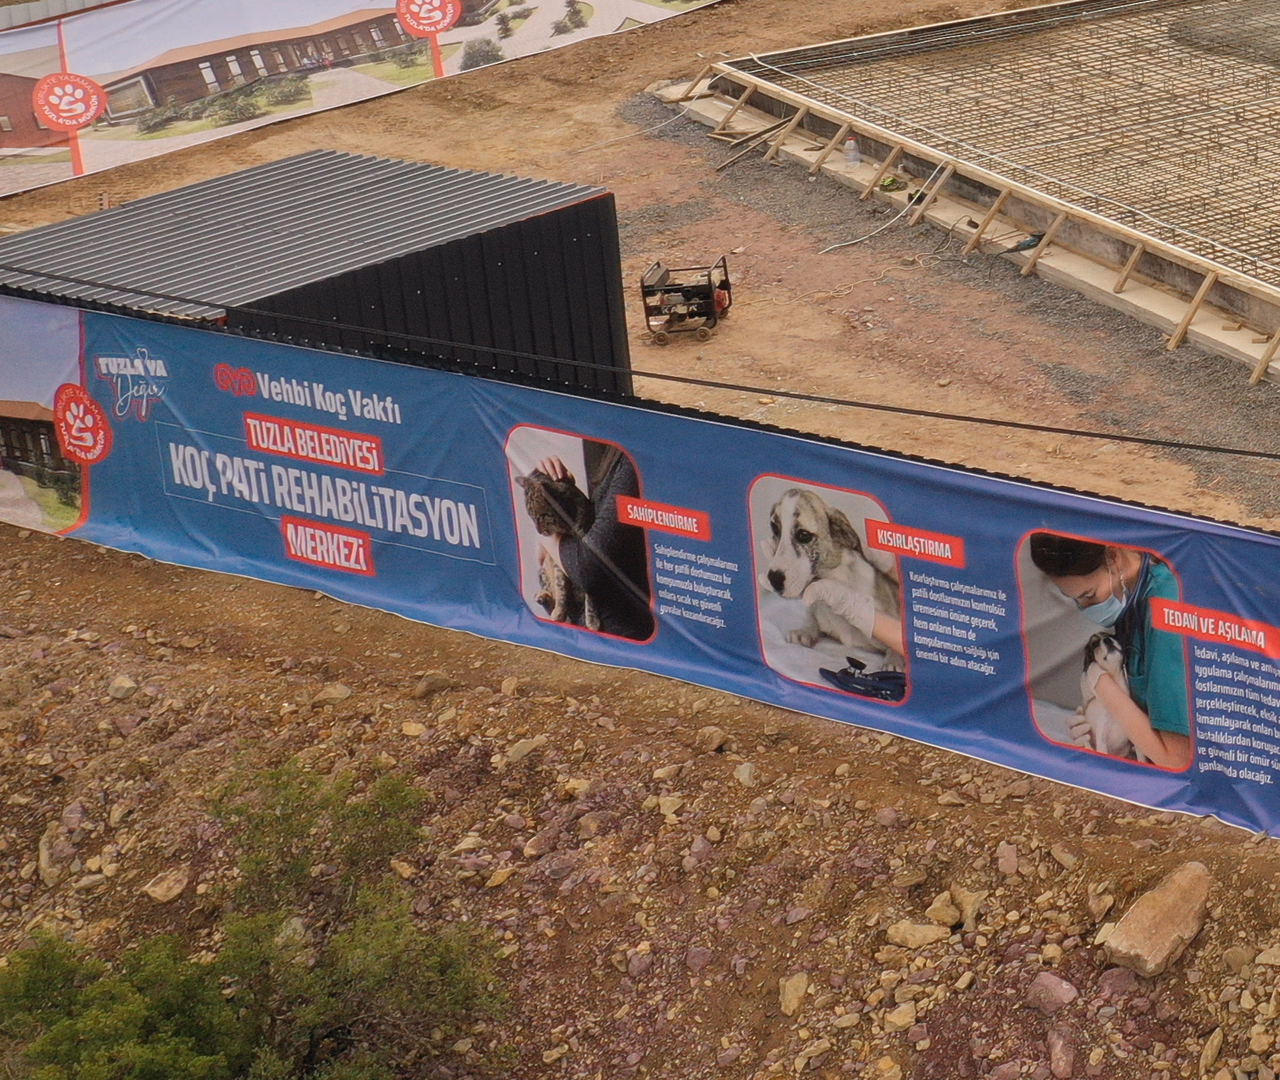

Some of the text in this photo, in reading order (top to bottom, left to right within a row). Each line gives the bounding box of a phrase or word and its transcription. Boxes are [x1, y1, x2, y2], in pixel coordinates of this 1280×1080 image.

[256, 372, 402, 424] Vehbi Koç Vakfı
[246, 418, 380, 471] TUZLA BELEDİYESİ
[169, 442, 481, 549] KOÇ PATİ REHABİLİTASYON
[627, 504, 698, 533] SAHİPLENDİRME
[286, 522, 367, 571] MERKEZİ
[877, 529, 952, 559] KISIRLAŞTIRMA
[1163, 608, 1266, 649] TEDAVİ VE AŞILAMA
[1222, 652, 1249, 668] aşılama
[1251, 661, 1259, 670] ve
[1245, 687, 1260, 702] tüm
[1197, 746, 1207, 756] ve
[1236, 750, 1249, 761] bir
[1249, 754, 1270, 768] ömür
[1239, 768, 1274, 785] olacağız.
